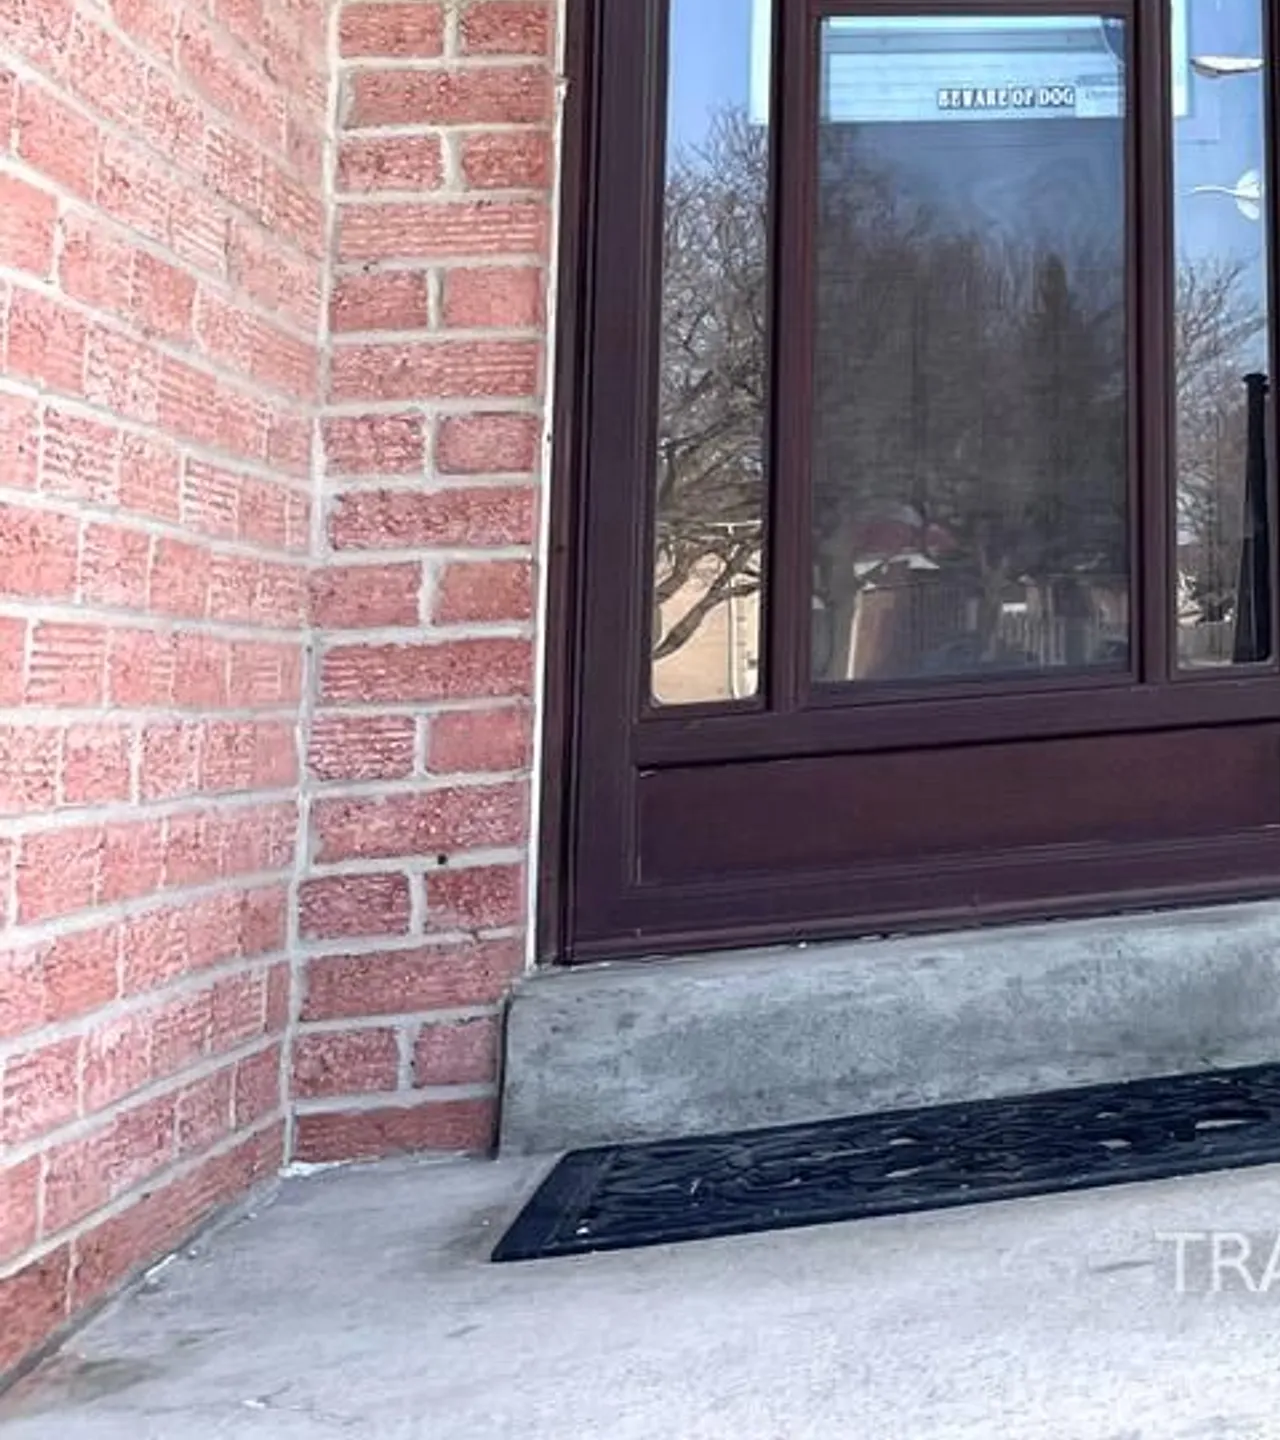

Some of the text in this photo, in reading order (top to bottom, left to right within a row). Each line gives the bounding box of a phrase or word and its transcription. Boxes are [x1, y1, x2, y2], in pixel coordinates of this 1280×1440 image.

[938, 86, 1075, 109] BEWARE OF DOG
